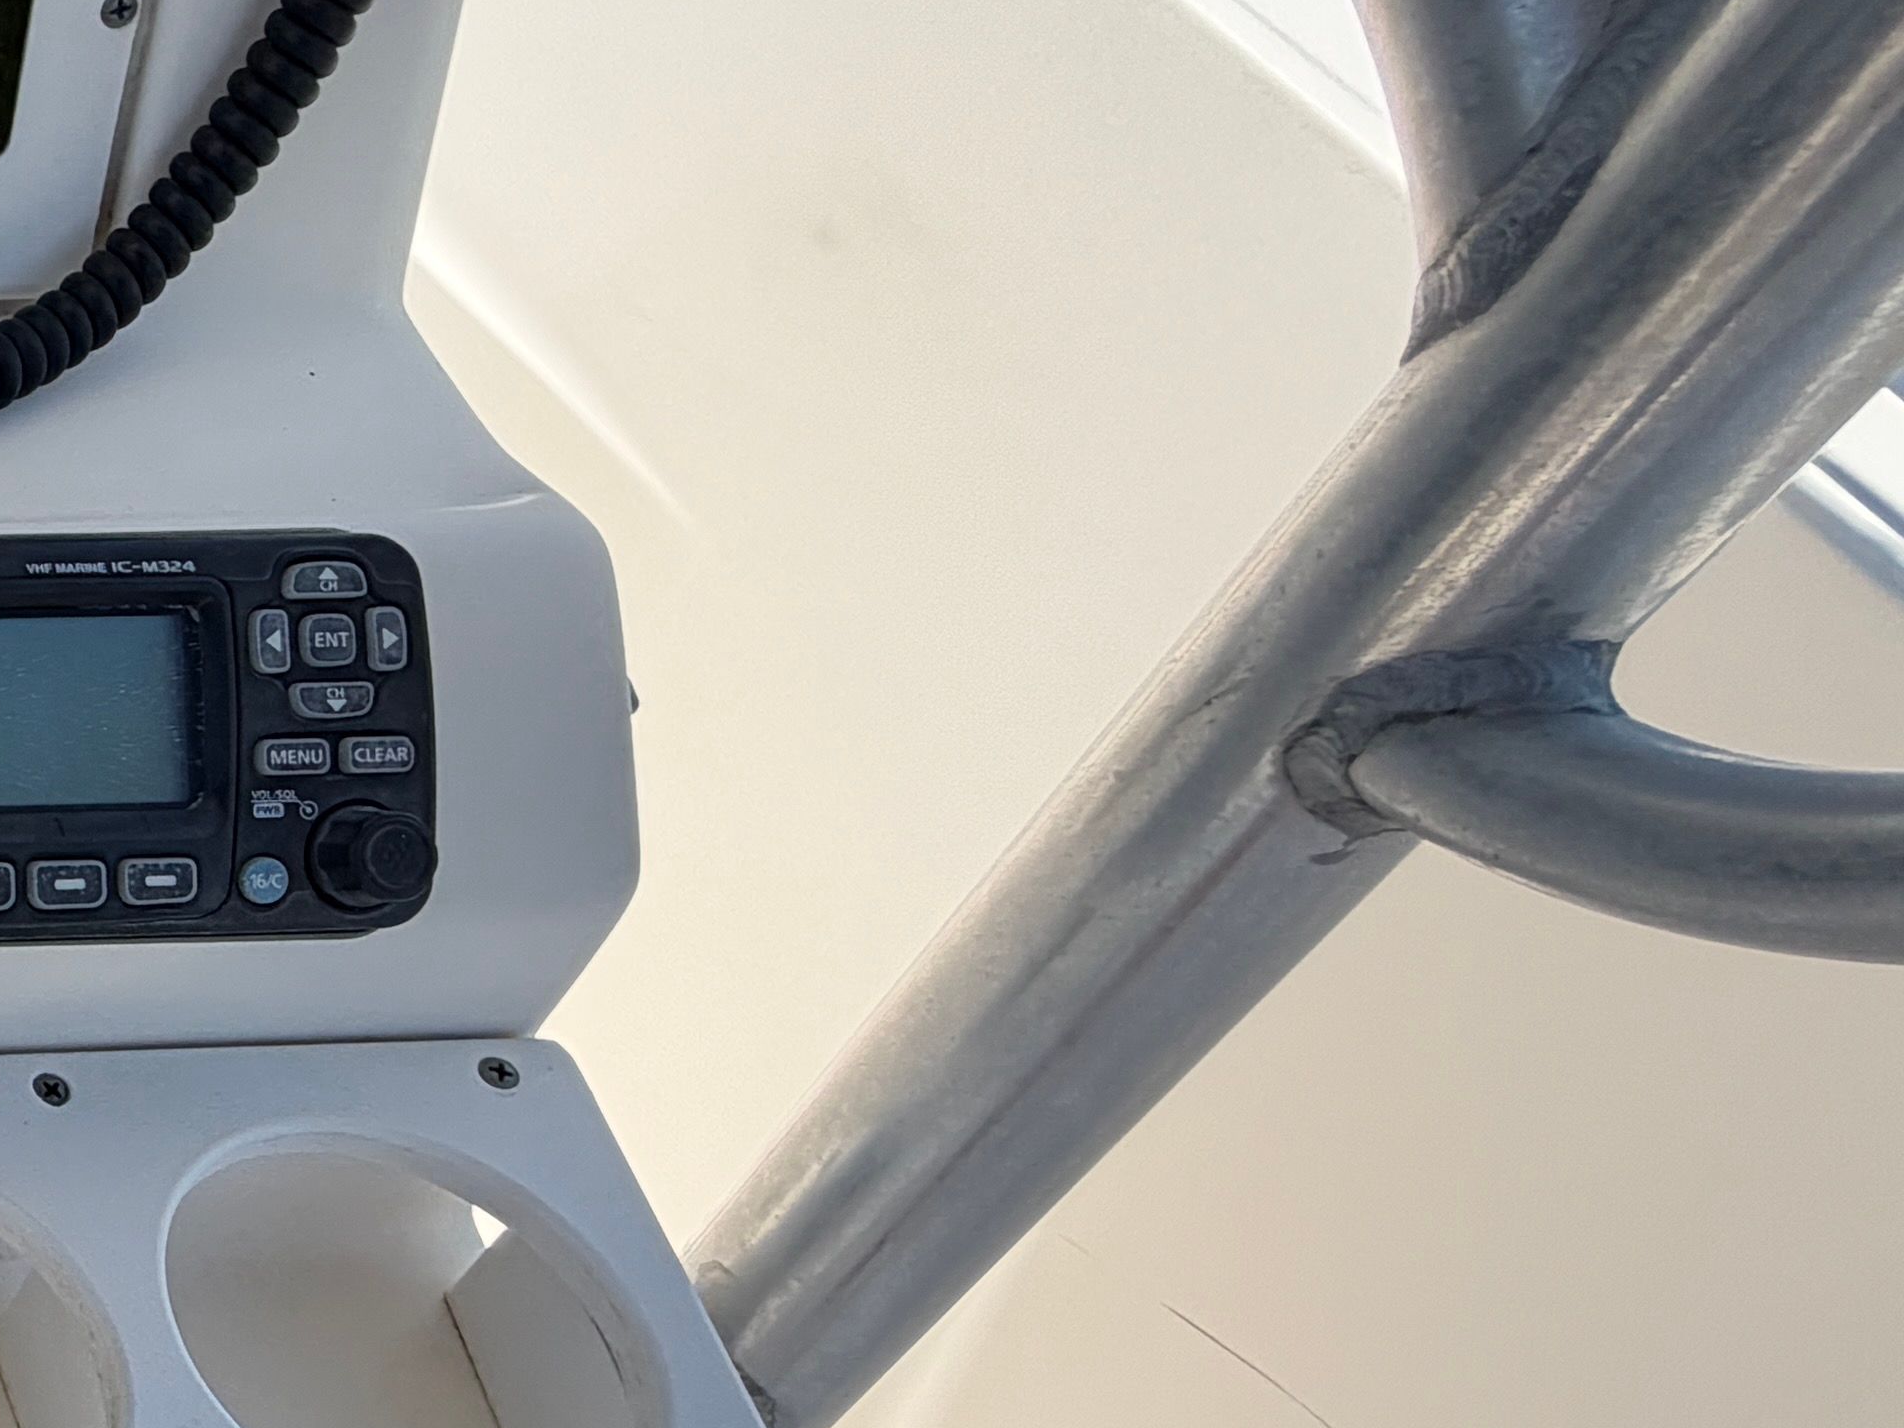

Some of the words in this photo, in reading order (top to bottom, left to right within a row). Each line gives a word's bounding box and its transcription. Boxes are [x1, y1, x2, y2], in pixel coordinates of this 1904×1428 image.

[25, 563, 51, 575] VHF
[55, 562, 107, 574] MARINE
[111, 560, 196, 574] IC-M324
[319, 581, 339, 592] CH
[314, 632, 350, 648] ENT
[326, 688, 345, 698] CH
[270, 748, 325, 765] MENU
[354, 746, 409, 763] CLEAR
[251, 790, 298, 801] VOL/SQL
[255, 806, 281, 815] PWR
